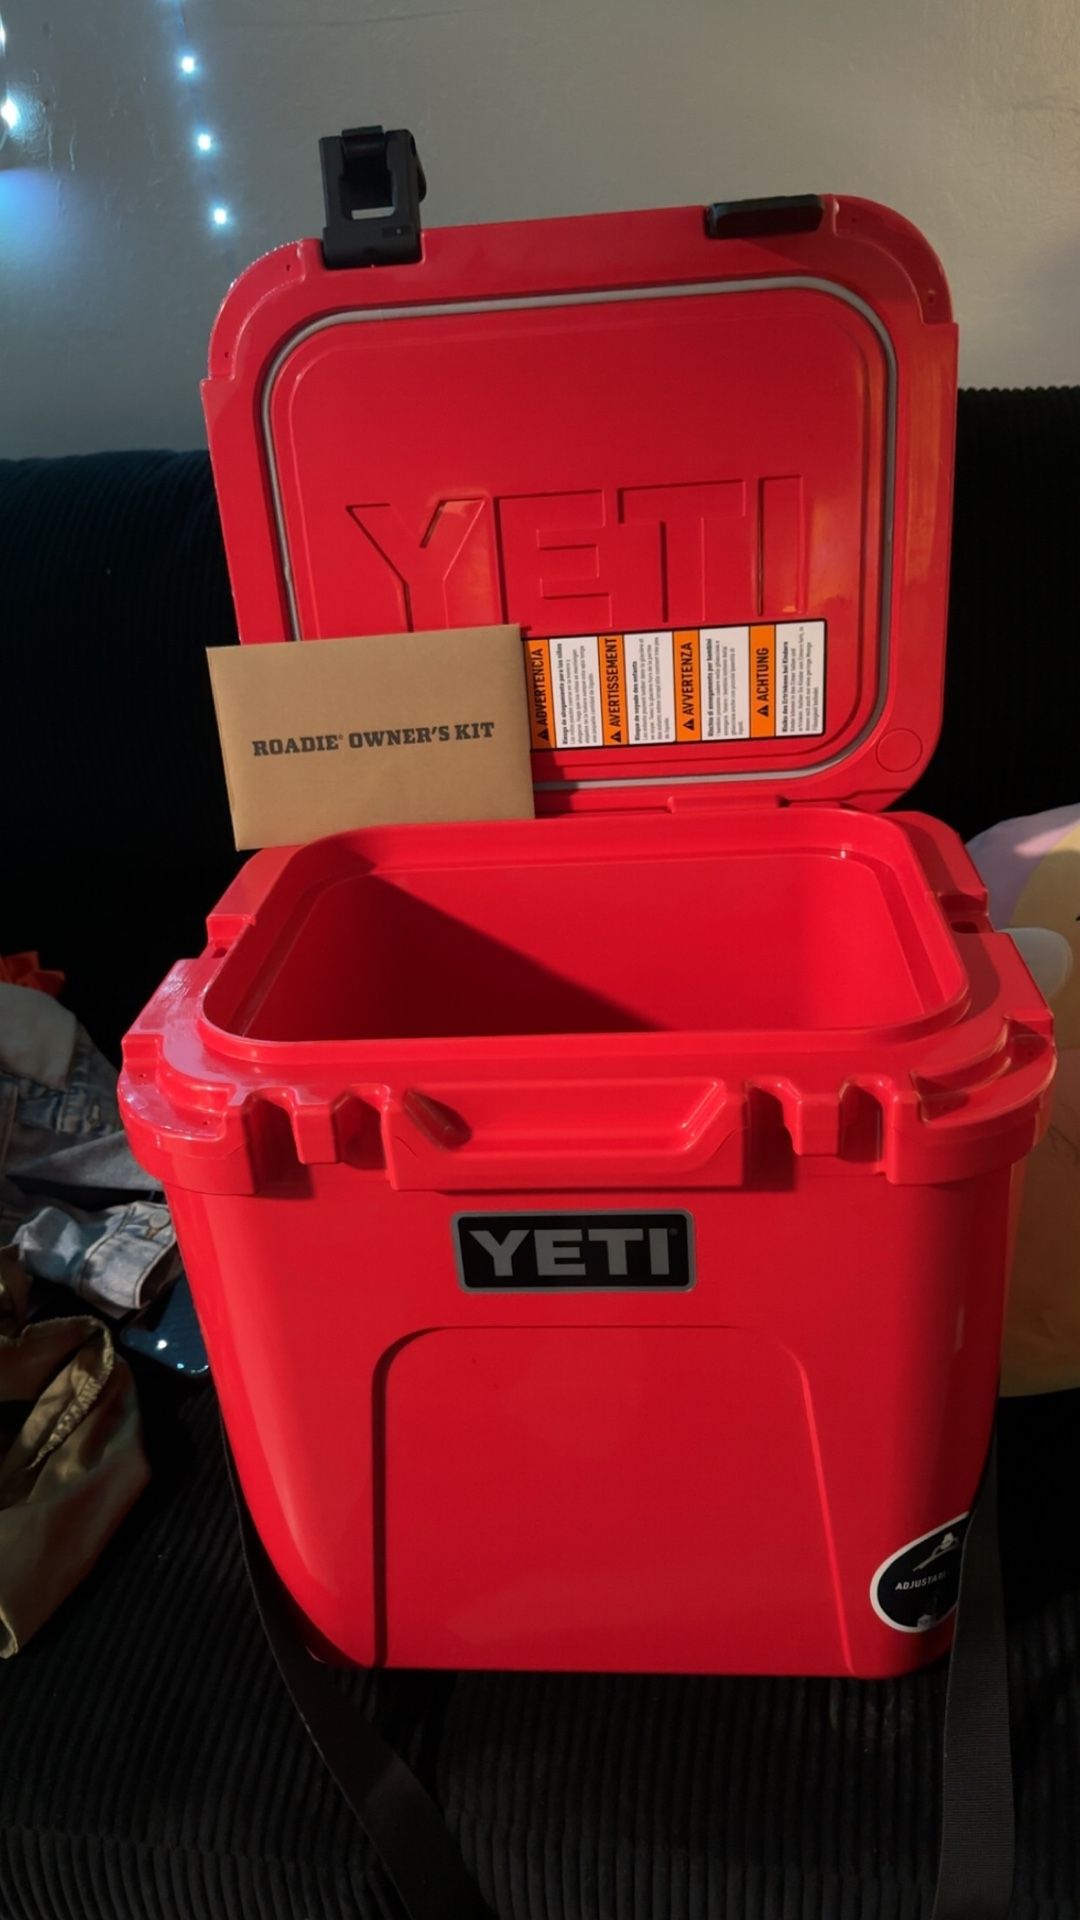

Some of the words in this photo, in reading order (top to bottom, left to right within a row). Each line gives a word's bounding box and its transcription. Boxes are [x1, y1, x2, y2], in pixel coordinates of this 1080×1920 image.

[346, 475, 806, 633] YETI
[531, 648, 548, 726] ADVERTENCIA
[604, 638, 621, 727] AVERTISSEMENT
[680, 642, 695, 716] AVVERTENZA
[756, 647, 769, 702] ACHTUNG
[252, 735, 341, 756] ROADIE
[348, 724, 450, 749] OWNER'S
[454, 721, 495, 741] KIT
[468, 1227, 671, 1277] YETI
